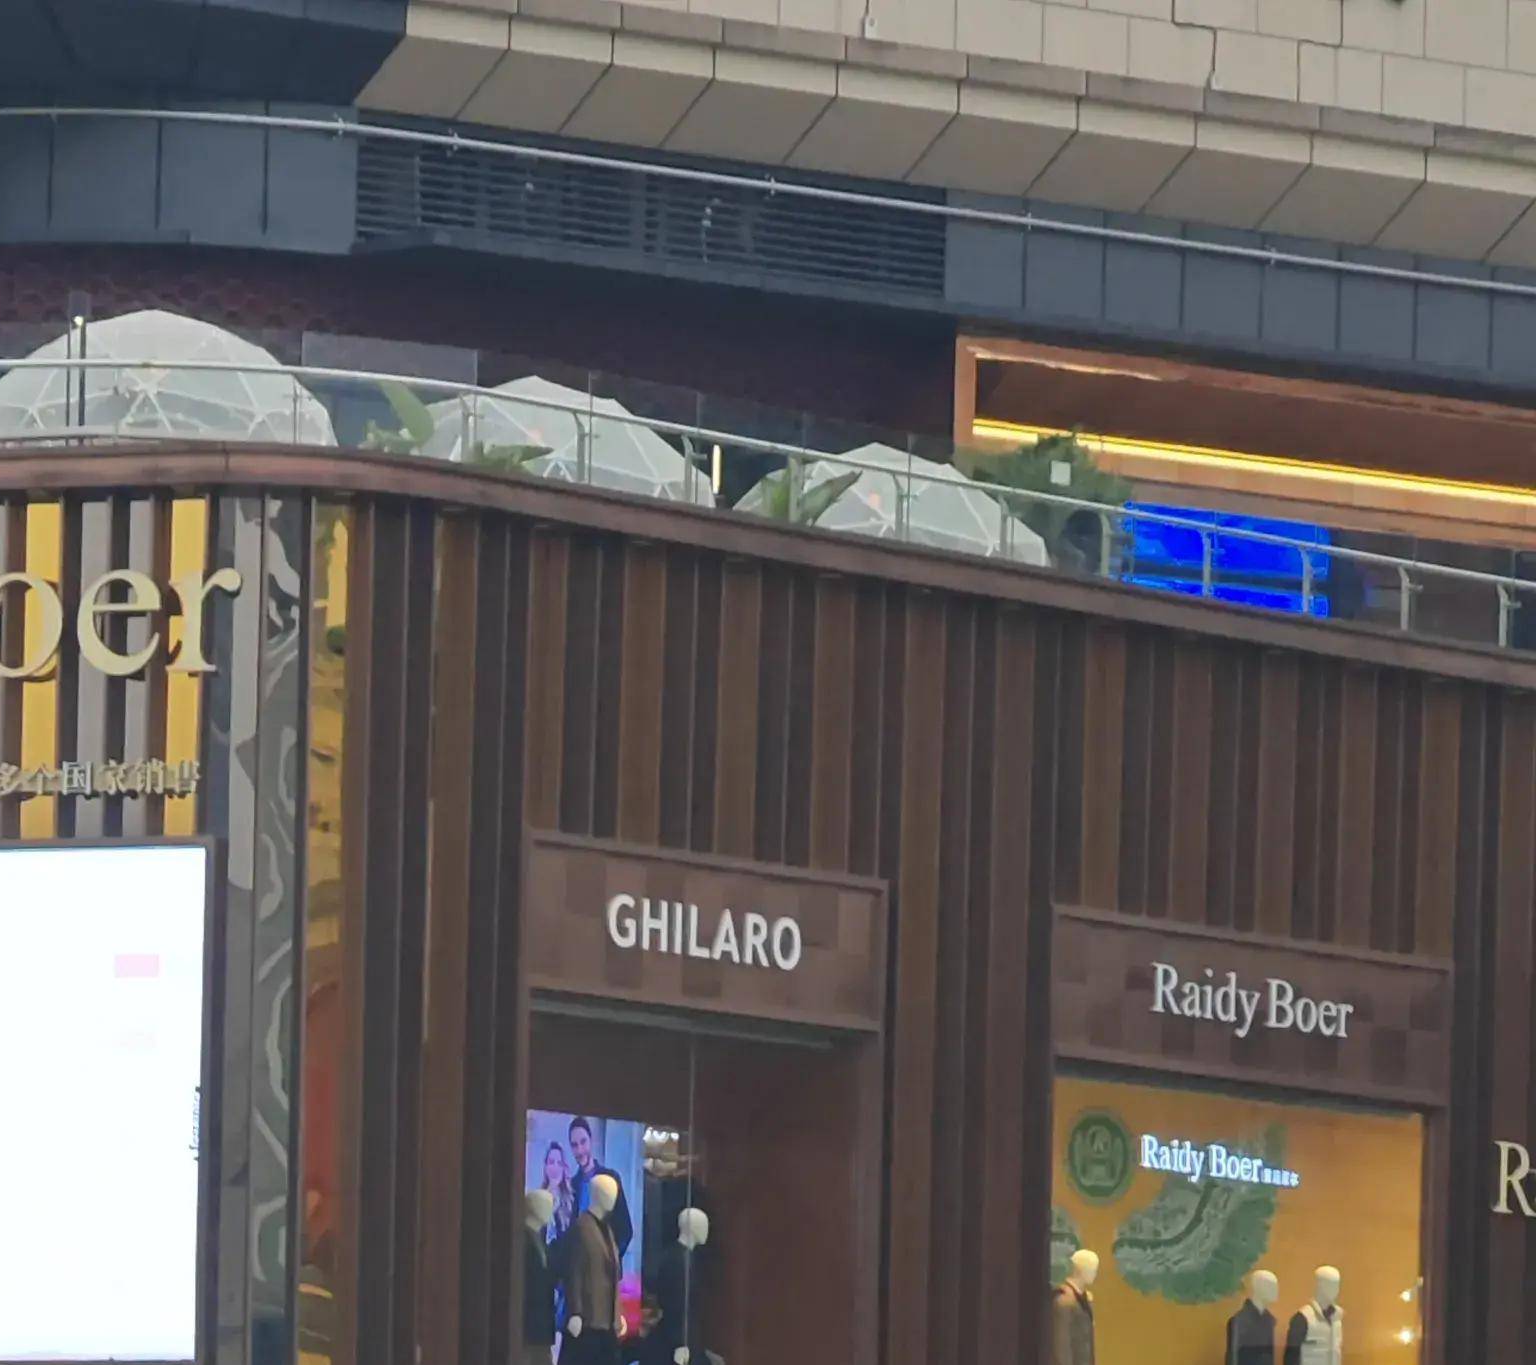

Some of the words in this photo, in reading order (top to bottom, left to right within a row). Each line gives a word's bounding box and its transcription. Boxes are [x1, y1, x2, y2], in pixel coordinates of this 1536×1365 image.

[606, 893, 802, 973] GHILARO
[1151, 962, 1262, 1038] Raidy
[1264, 977, 1354, 1040] Boer
[1139, 1133, 1205, 1183] Raidy
[1208, 1144, 1264, 1184] Boer
[1492, 1140, 1536, 1217] R
